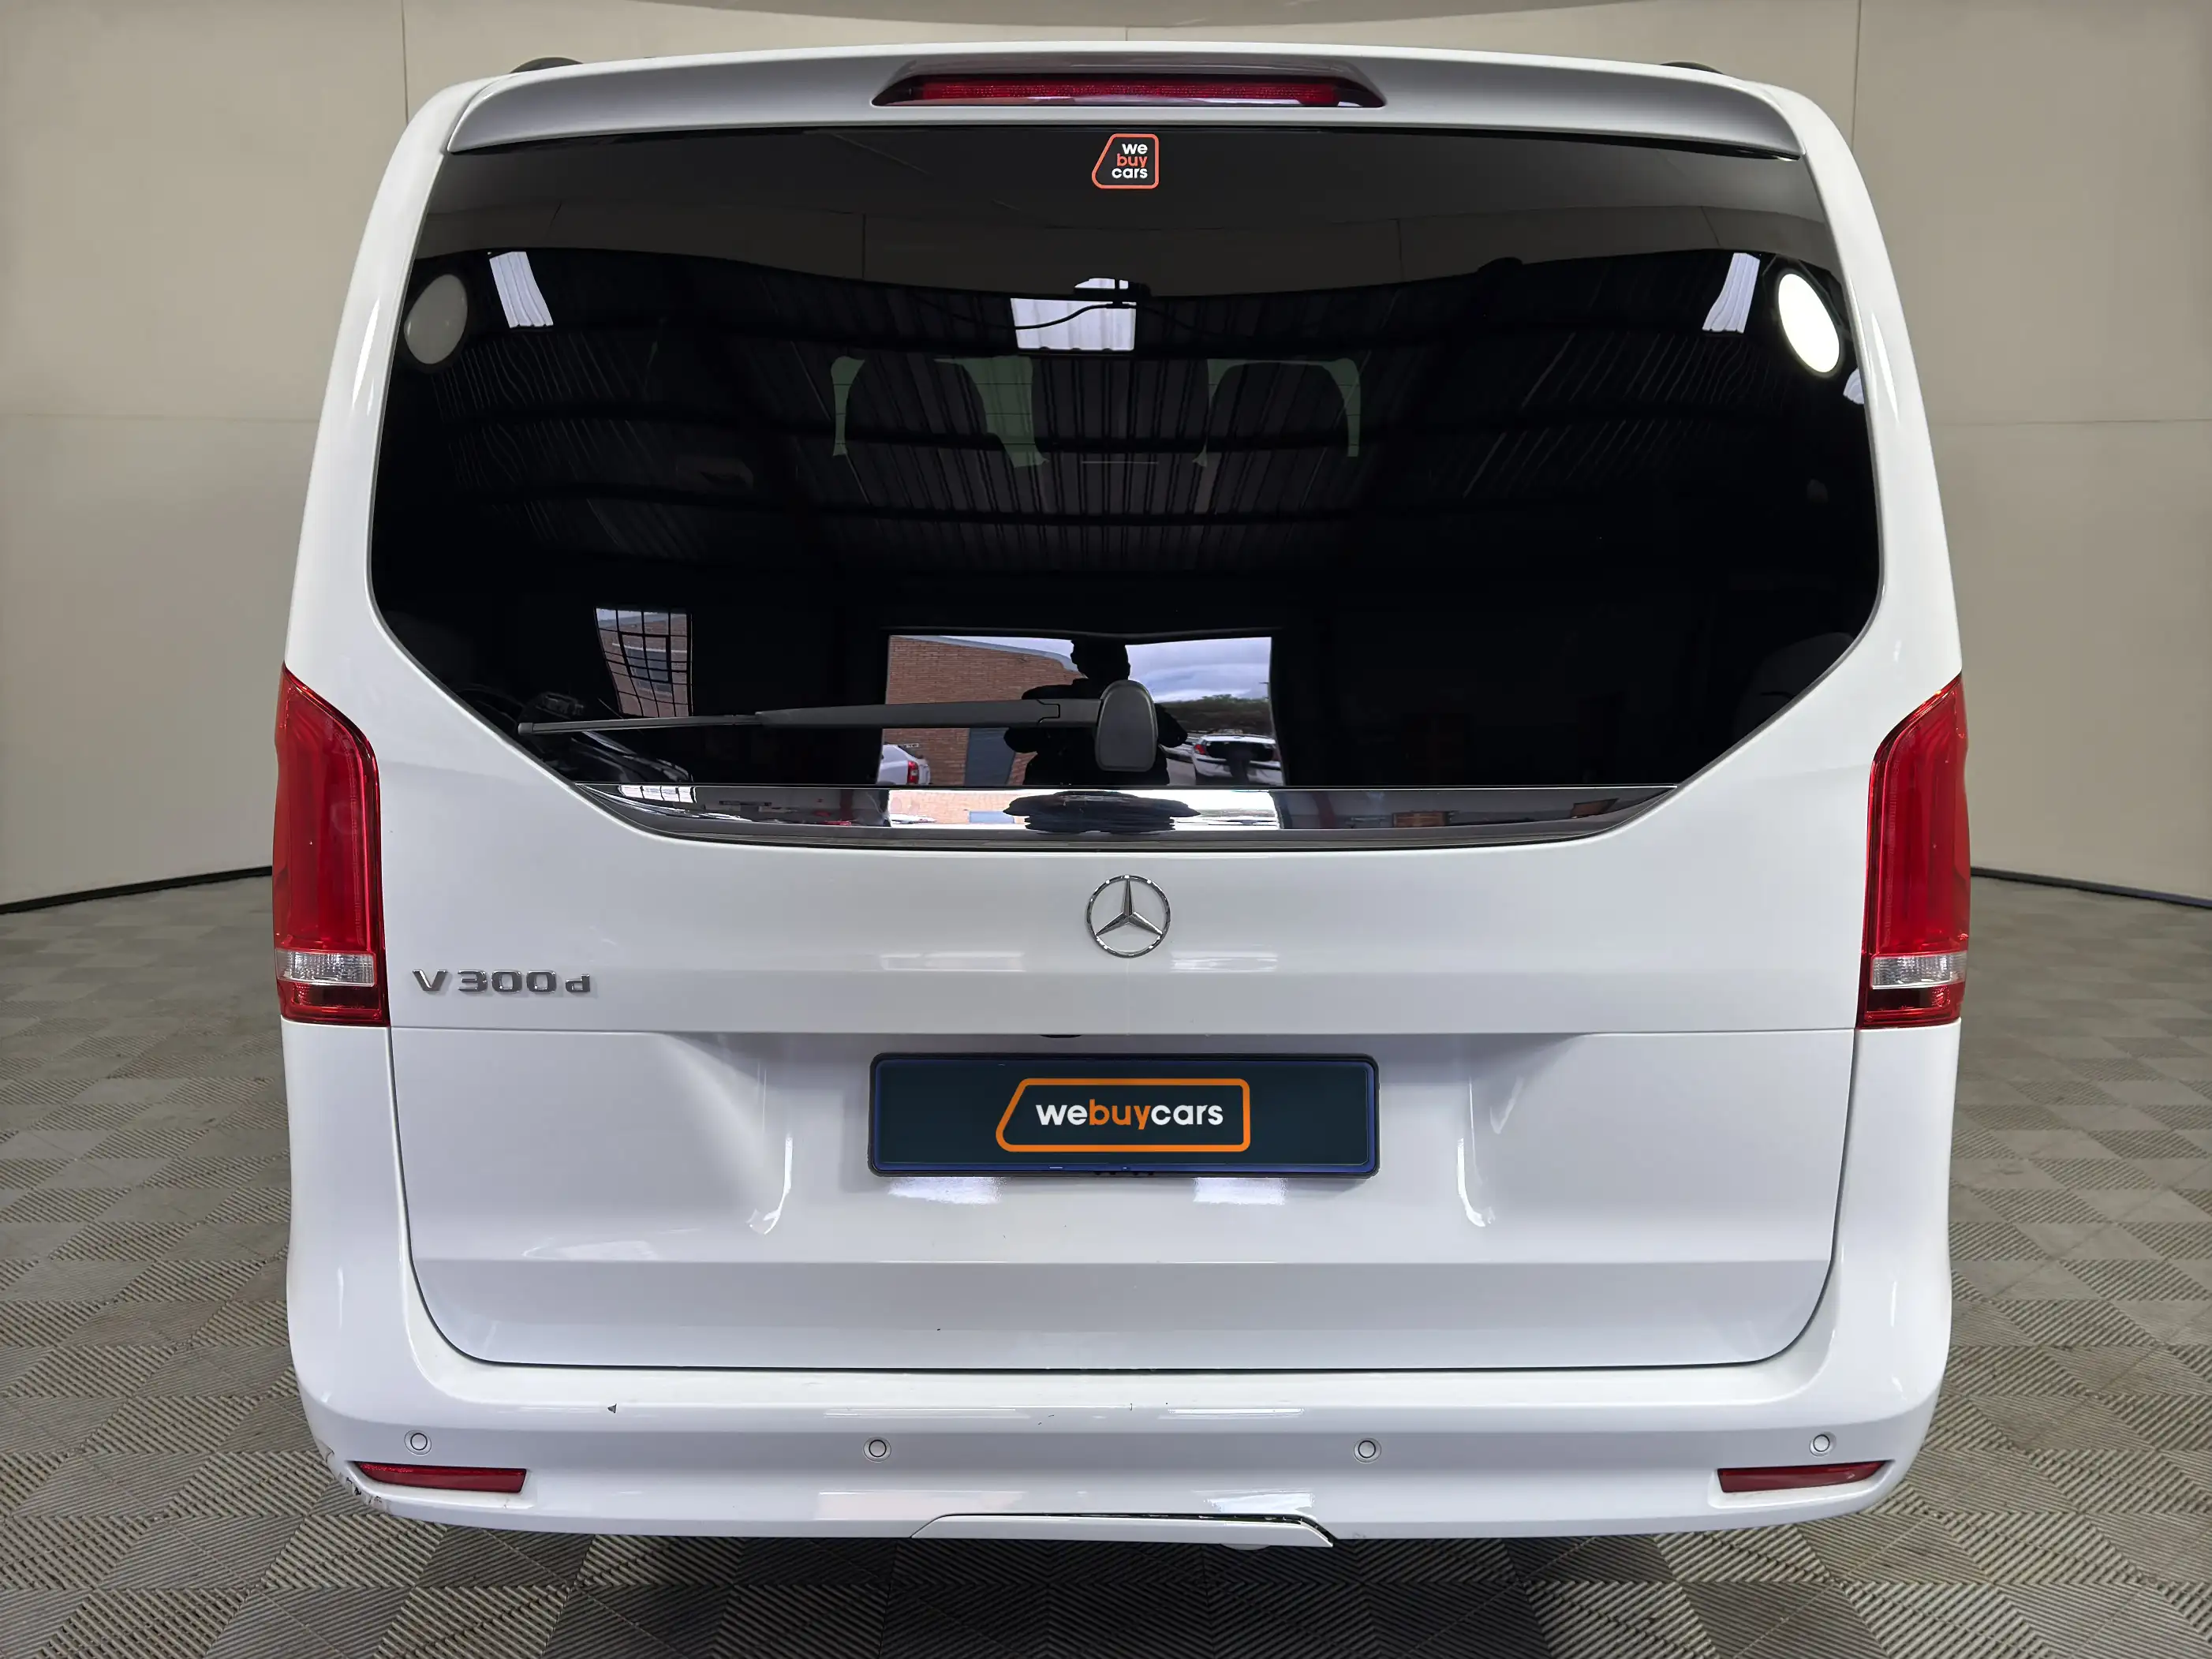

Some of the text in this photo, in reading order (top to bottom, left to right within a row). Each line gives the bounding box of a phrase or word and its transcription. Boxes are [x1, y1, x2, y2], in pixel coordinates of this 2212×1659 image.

[1122, 144, 1148, 154] we
[1116, 153, 1148, 168] buy
[1112, 168, 1148, 178] cars
[1035, 1099, 1224, 1130] webuycars
